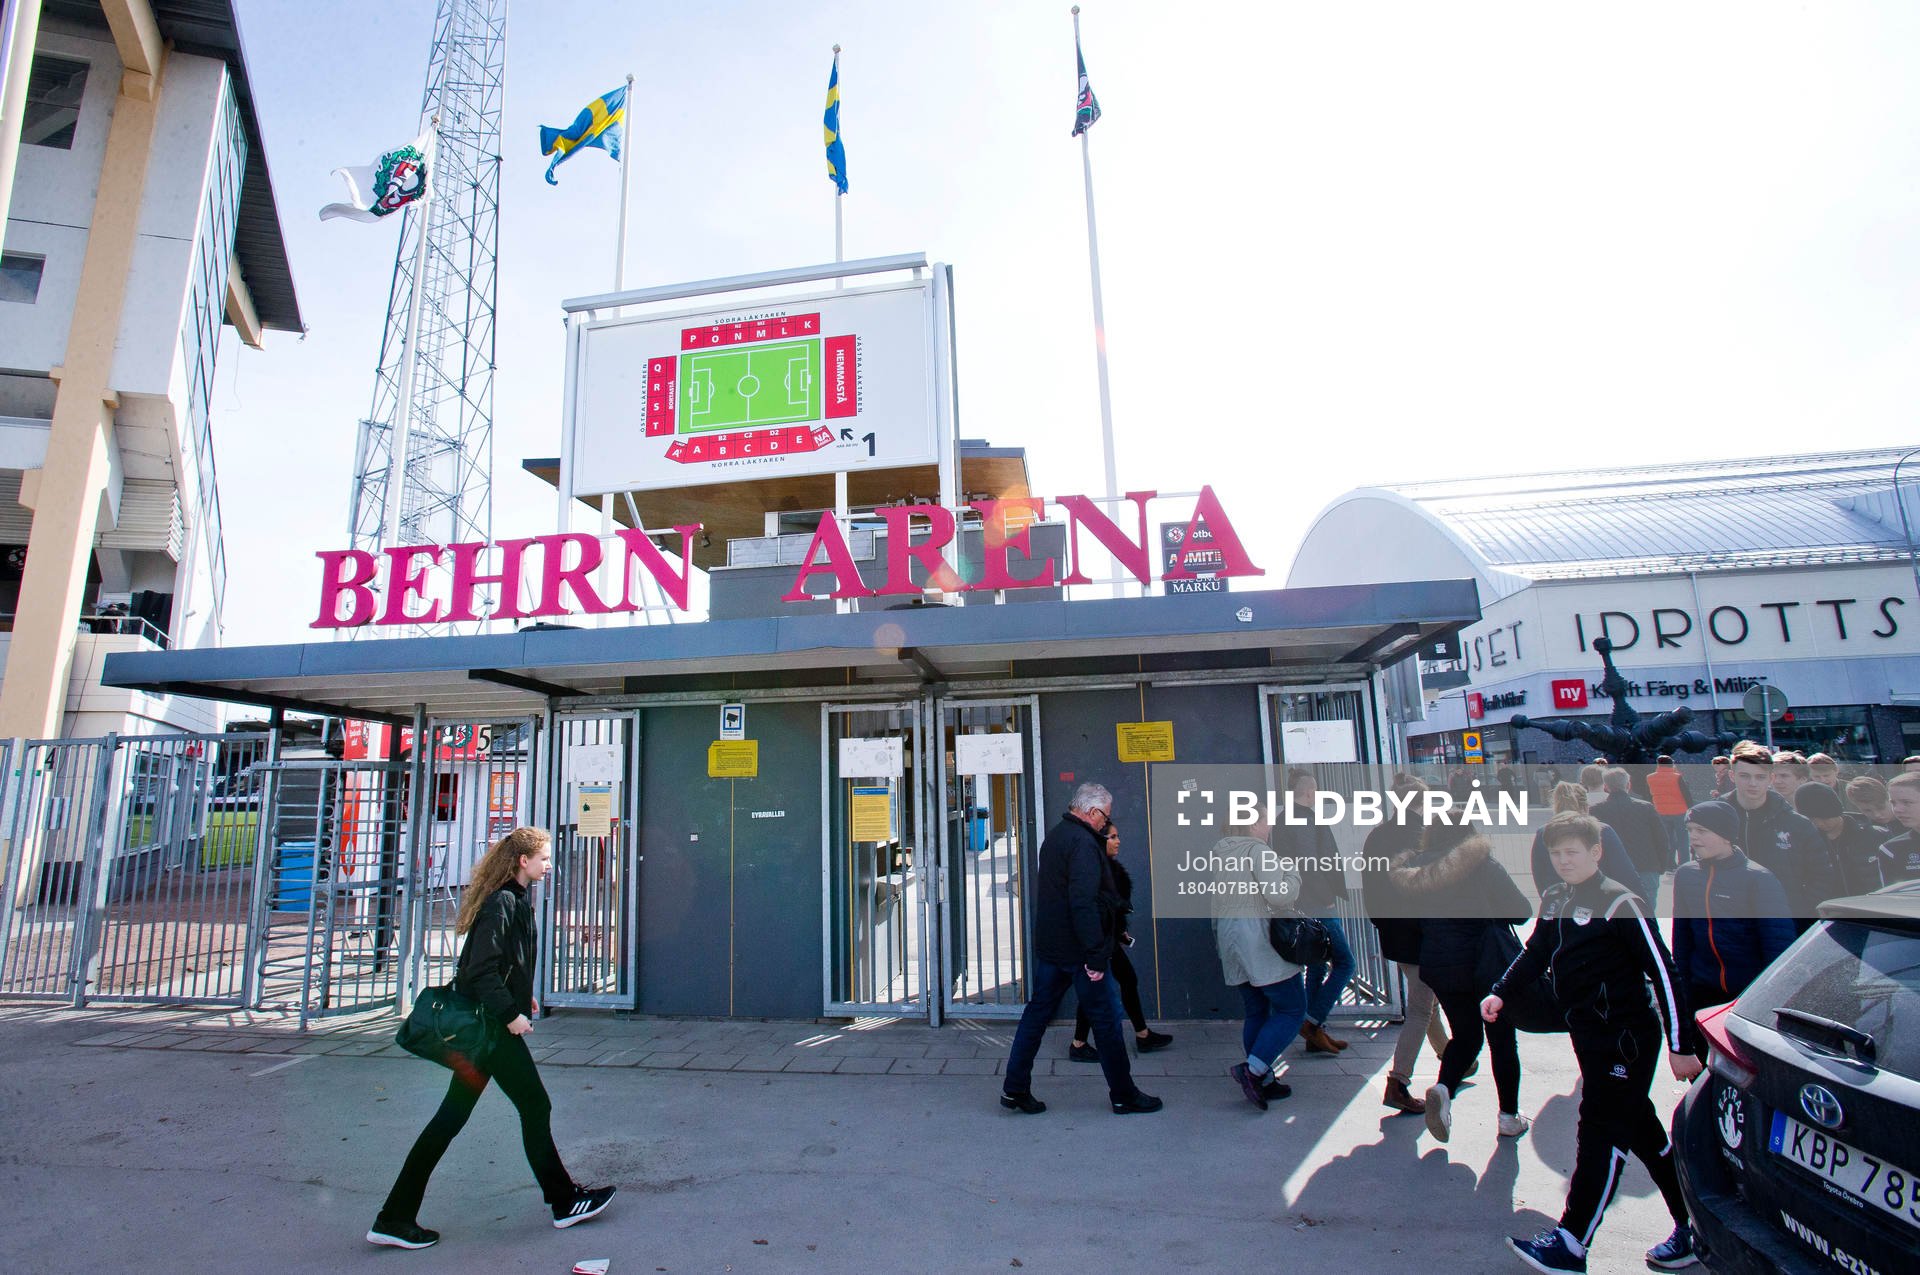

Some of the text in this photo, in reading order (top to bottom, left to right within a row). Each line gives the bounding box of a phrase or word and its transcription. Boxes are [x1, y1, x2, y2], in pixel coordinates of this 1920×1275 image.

[690, 321, 812, 343] P O N M L K
[654, 363, 662, 372] Q
[836, 349, 848, 404] HEMMASTÅ
[653, 383, 661, 392] R
[653, 402, 660, 411] S
[653, 422, 659, 430] T
[693, 446, 701, 454] A
[720, 447, 727, 455] B
[744, 444, 751, 452] C
[770, 442, 778, 450] D
[796, 435, 803, 444] E
[813, 431, 830, 445] NA
[862, 432, 875, 456] 1
[309, 484, 1266, 629] BEHRN ARENA
[1575, 596, 1905, 652] IDROTTS
[1560, 687, 1582, 702] ny
[1647, 680, 1689, 699] Färg
[1694, 679, 1710, 694] &
[476, 725, 491, 752] 5
[45, 747, 56, 769] 4
[1791, 1123, 1849, 1177] KBP
[1823, 1181, 1864, 1209] Toyota Örebro
